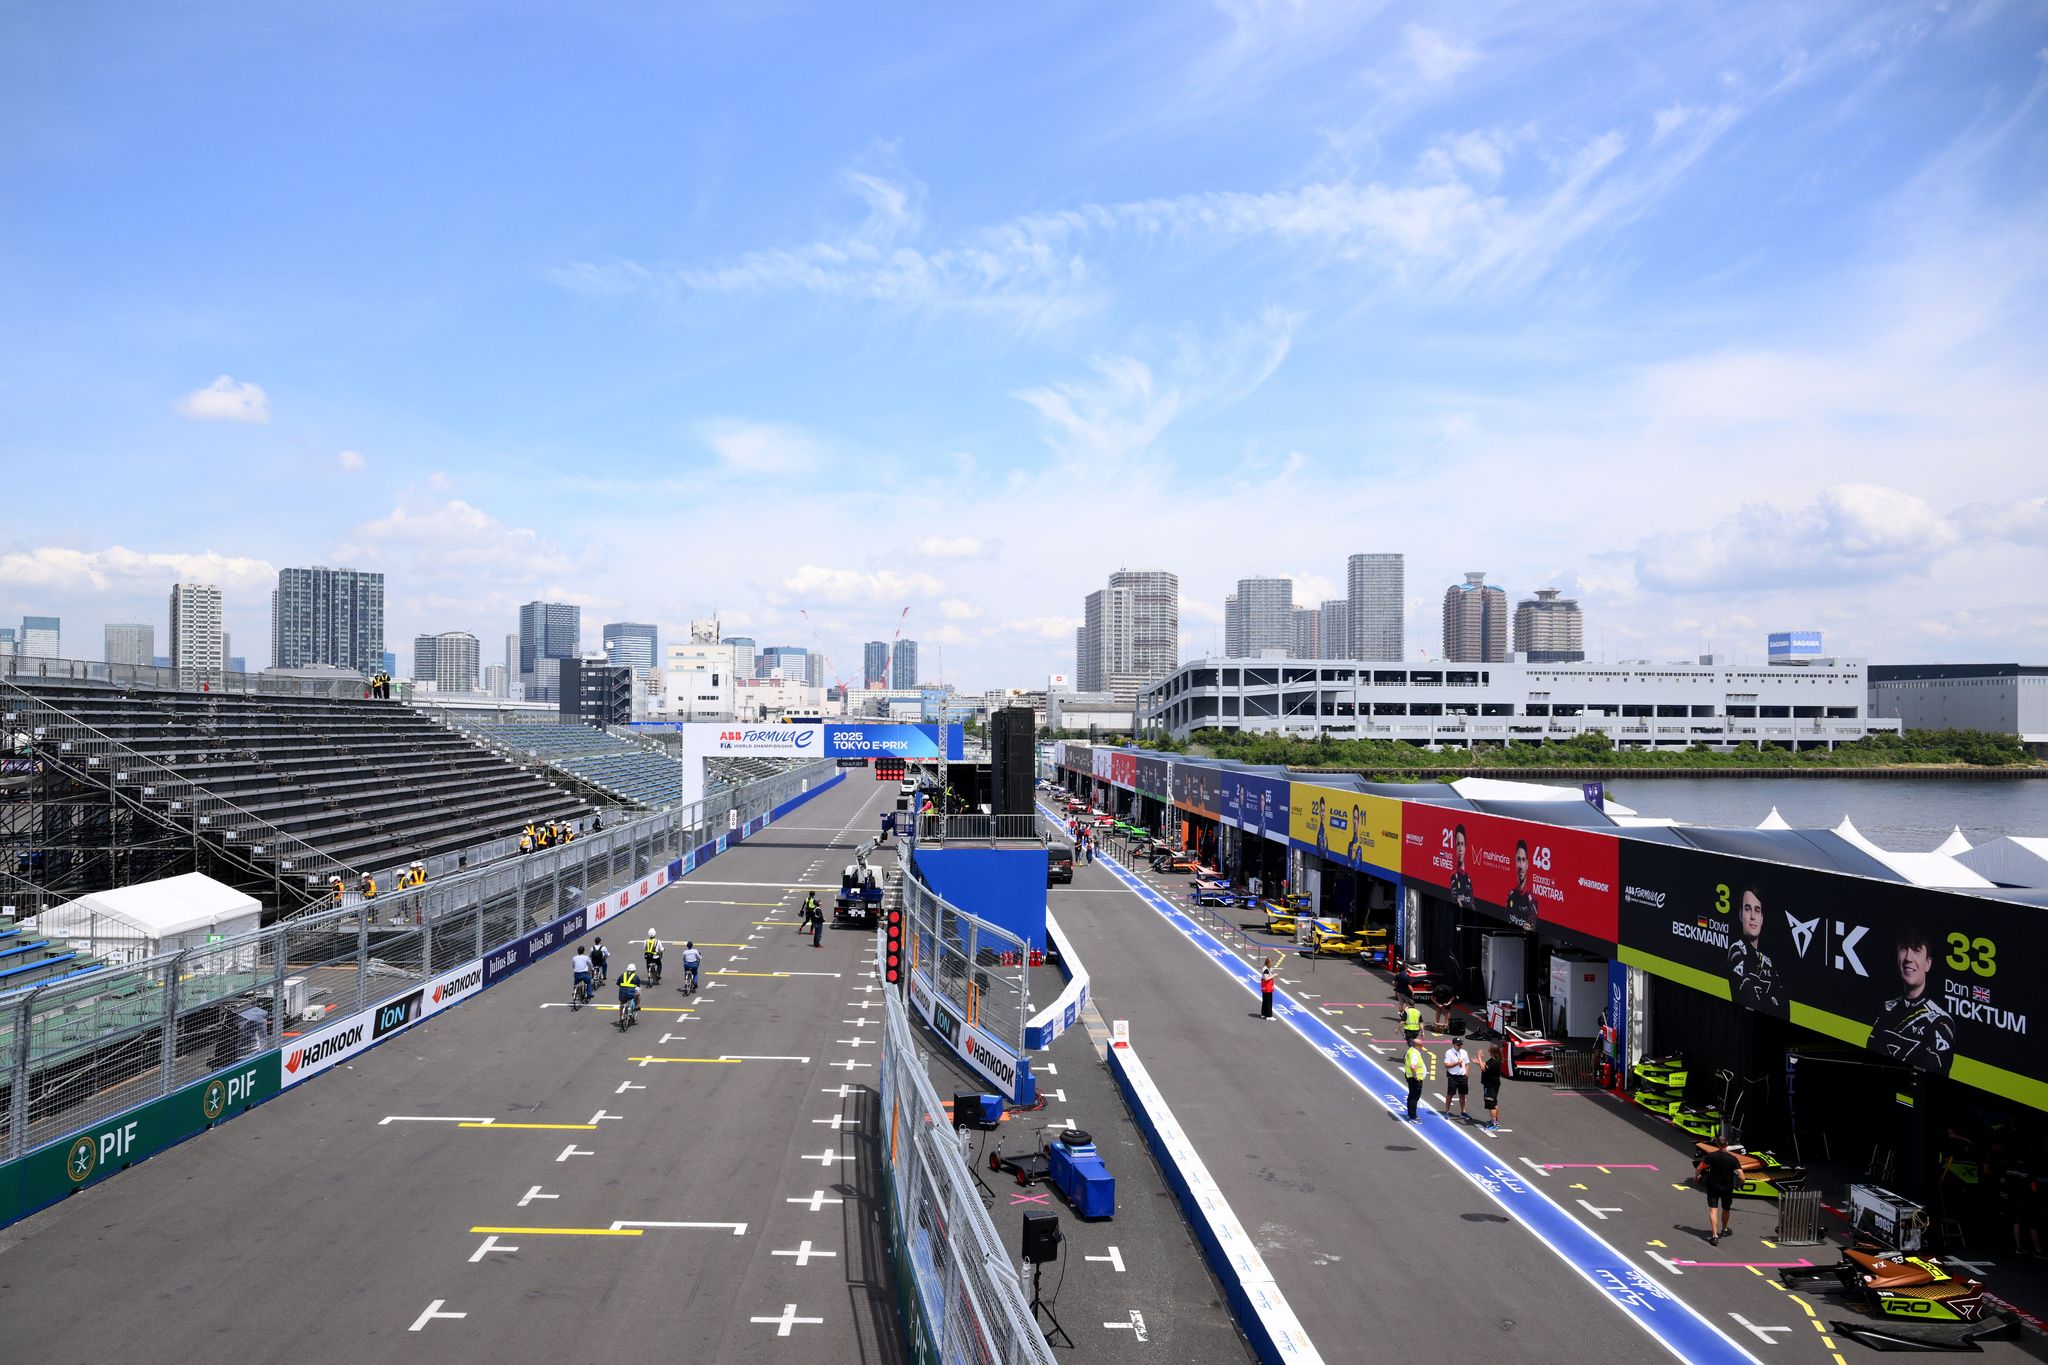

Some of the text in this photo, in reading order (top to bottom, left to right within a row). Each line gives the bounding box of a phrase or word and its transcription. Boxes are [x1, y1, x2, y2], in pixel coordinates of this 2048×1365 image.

[720, 732, 742, 740] ABB
[742, 731, 796, 742] FORMULA
[833, 732, 863, 740] 2025
[833, 742, 908, 750] TOKYO E-PRIX
[1312, 801, 1319, 815] 22
[1330, 808, 1348, 818] LOLA
[1360, 810, 1366, 826] 11
[1442, 828, 1453, 848] 21
[1432, 856, 1440, 866] DE
[1483, 851, 1510, 864] mahindra
[1533, 846, 1551, 871] 48
[640, 881, 648, 897] ABB
[1533, 883, 1564, 902] MORTARA
[1634, 887, 1657, 899] FORMULA
[620, 891, 628, 908] ABB
[1716, 884, 1730, 914] 3
[595, 902, 606, 922] ABB
[562, 920, 575, 938] Julius
[1672, 921, 1729, 949] BECKMANN
[1709, 919, 1729, 933] David
[529, 932, 553, 957] Julius Bär
[1946, 932, 1996, 977] 33
[489, 950, 517, 978] Julius Bär
[1945, 979, 1969, 997] Dan
[1944, 995, 2026, 1035] TICKTUM
[228, 1069, 257, 1105] PIF
[100, 1121, 138, 1165] PIF
[1874, 1214, 1894, 1234] BOOST
[1892, 1256, 1904, 1264] 33
